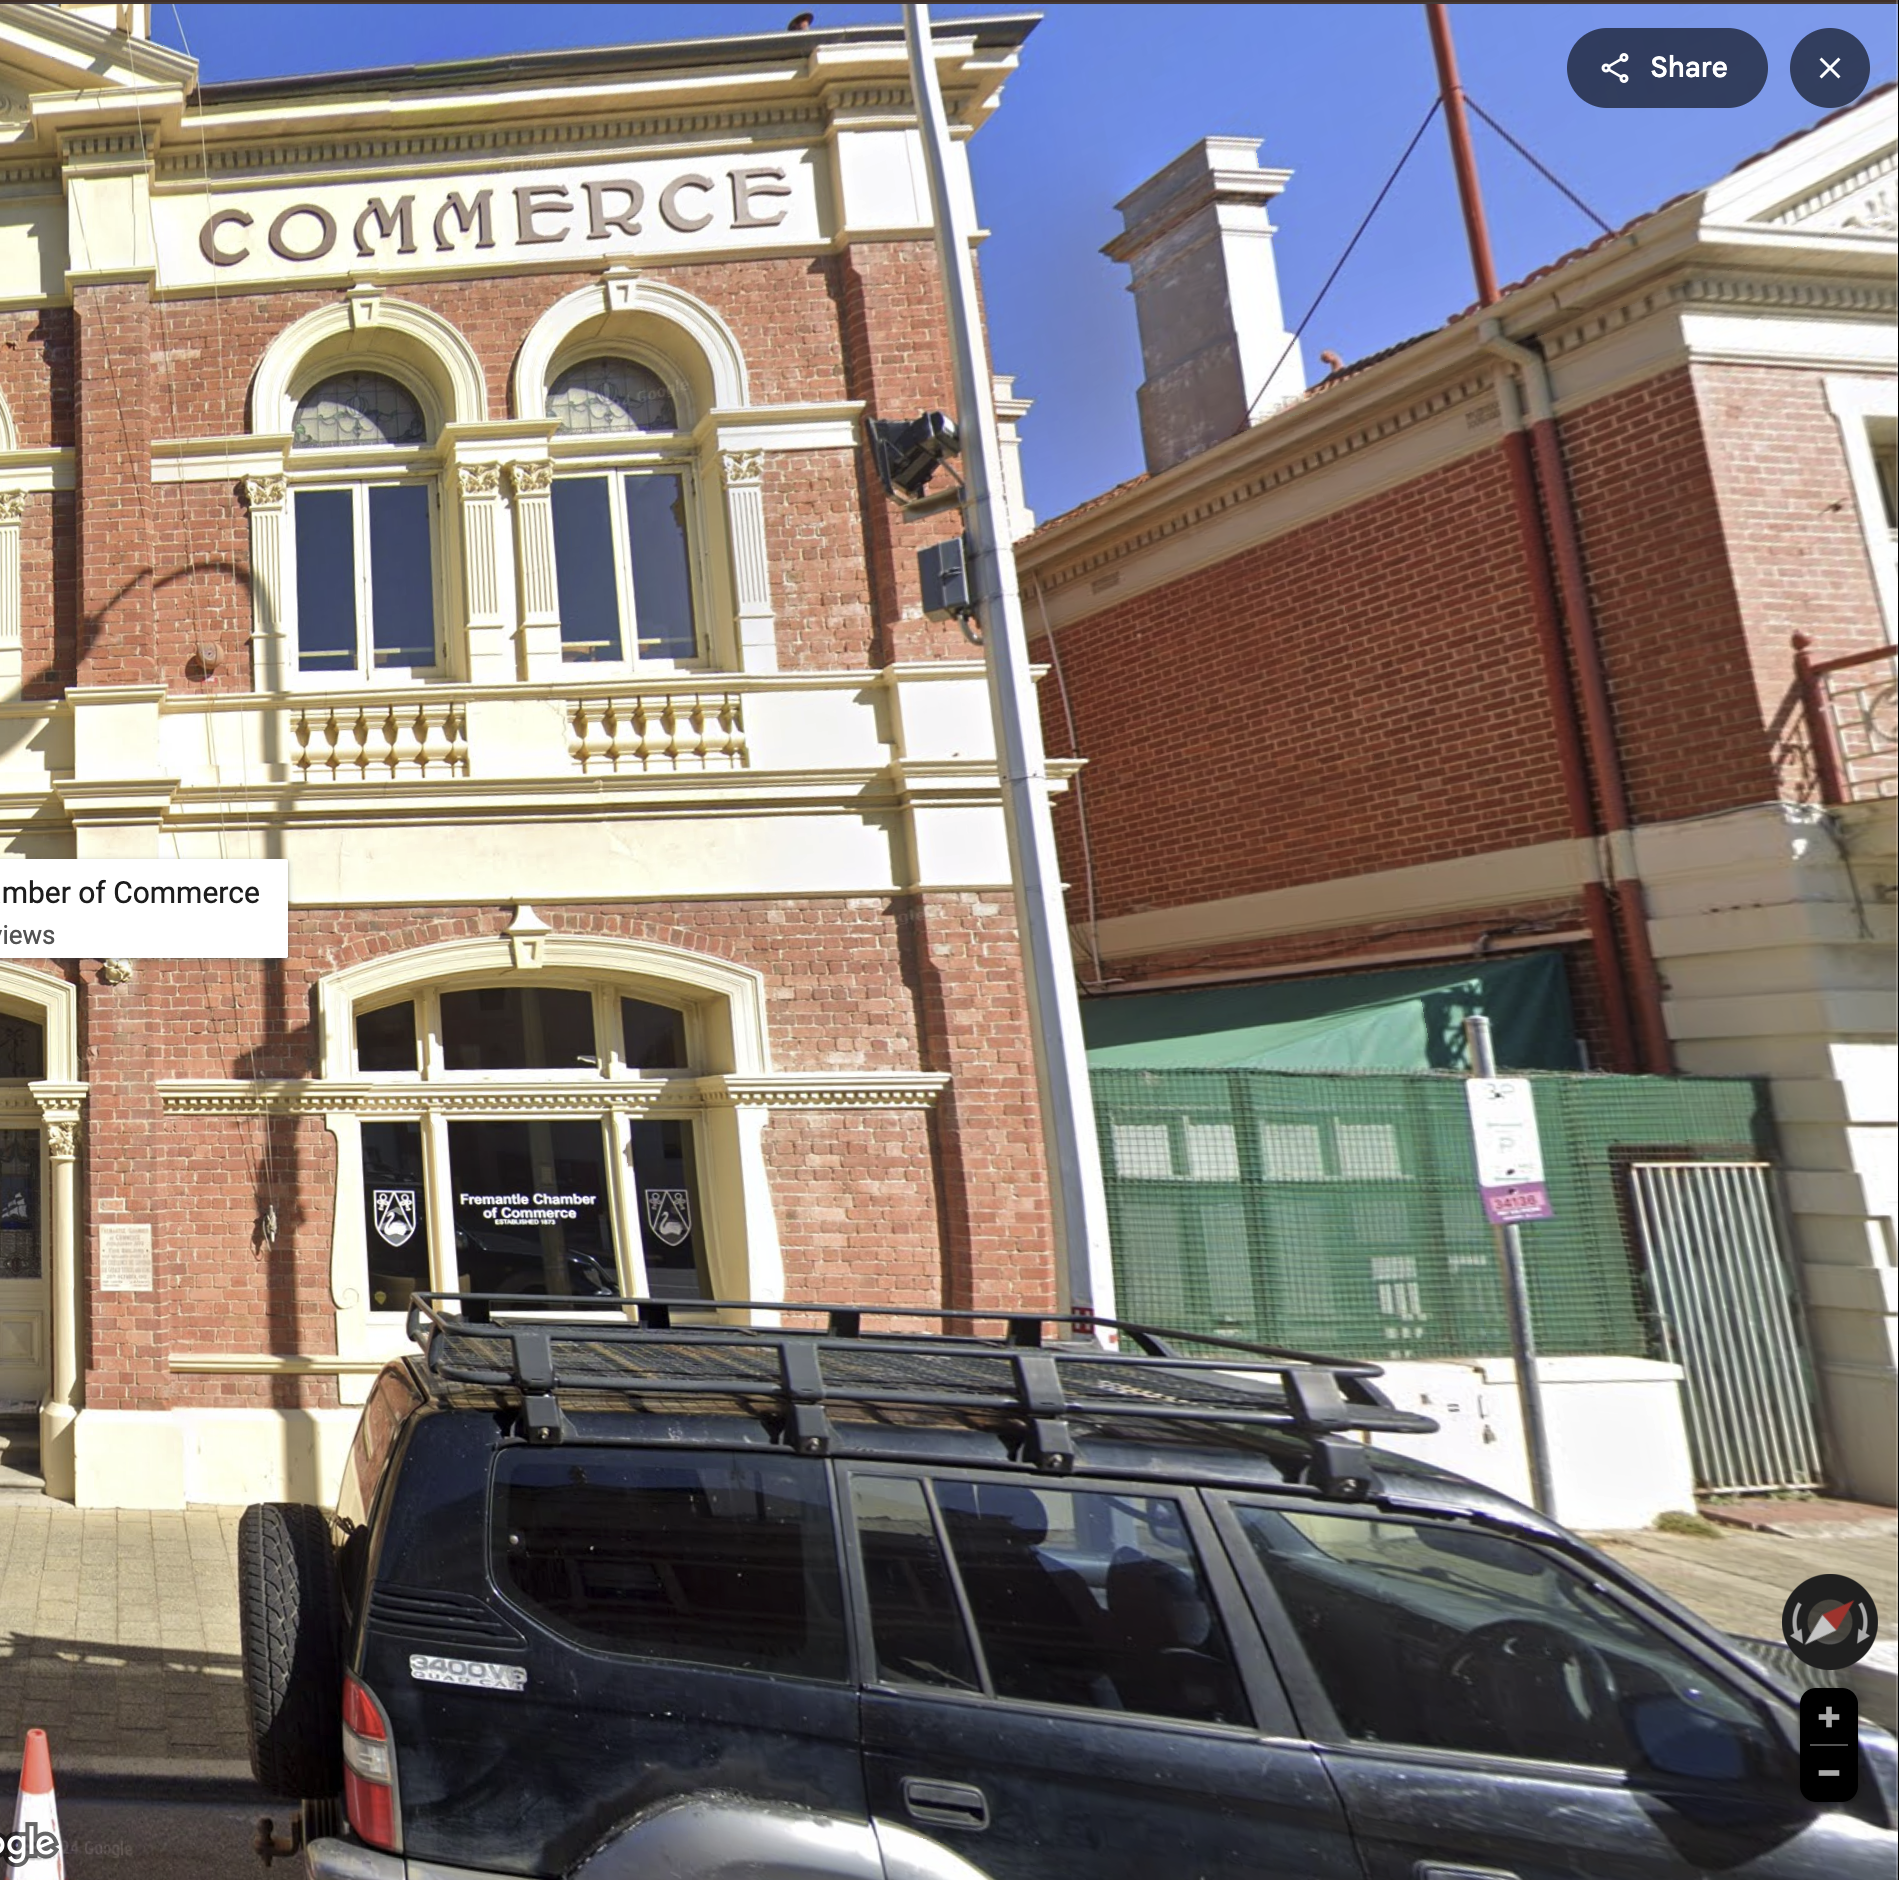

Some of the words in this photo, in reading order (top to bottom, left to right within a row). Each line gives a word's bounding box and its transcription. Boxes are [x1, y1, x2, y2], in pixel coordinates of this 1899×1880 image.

[199, 167, 793, 267] COMMERCE
[459, 1193, 530, 1205] Fremantle
[532, 1193, 597, 1206] Chamber
[482, 1207, 498, 1219] of
[501, 1207, 577, 1219] Commerce
[411, 1671, 471, 1684] QUAD
